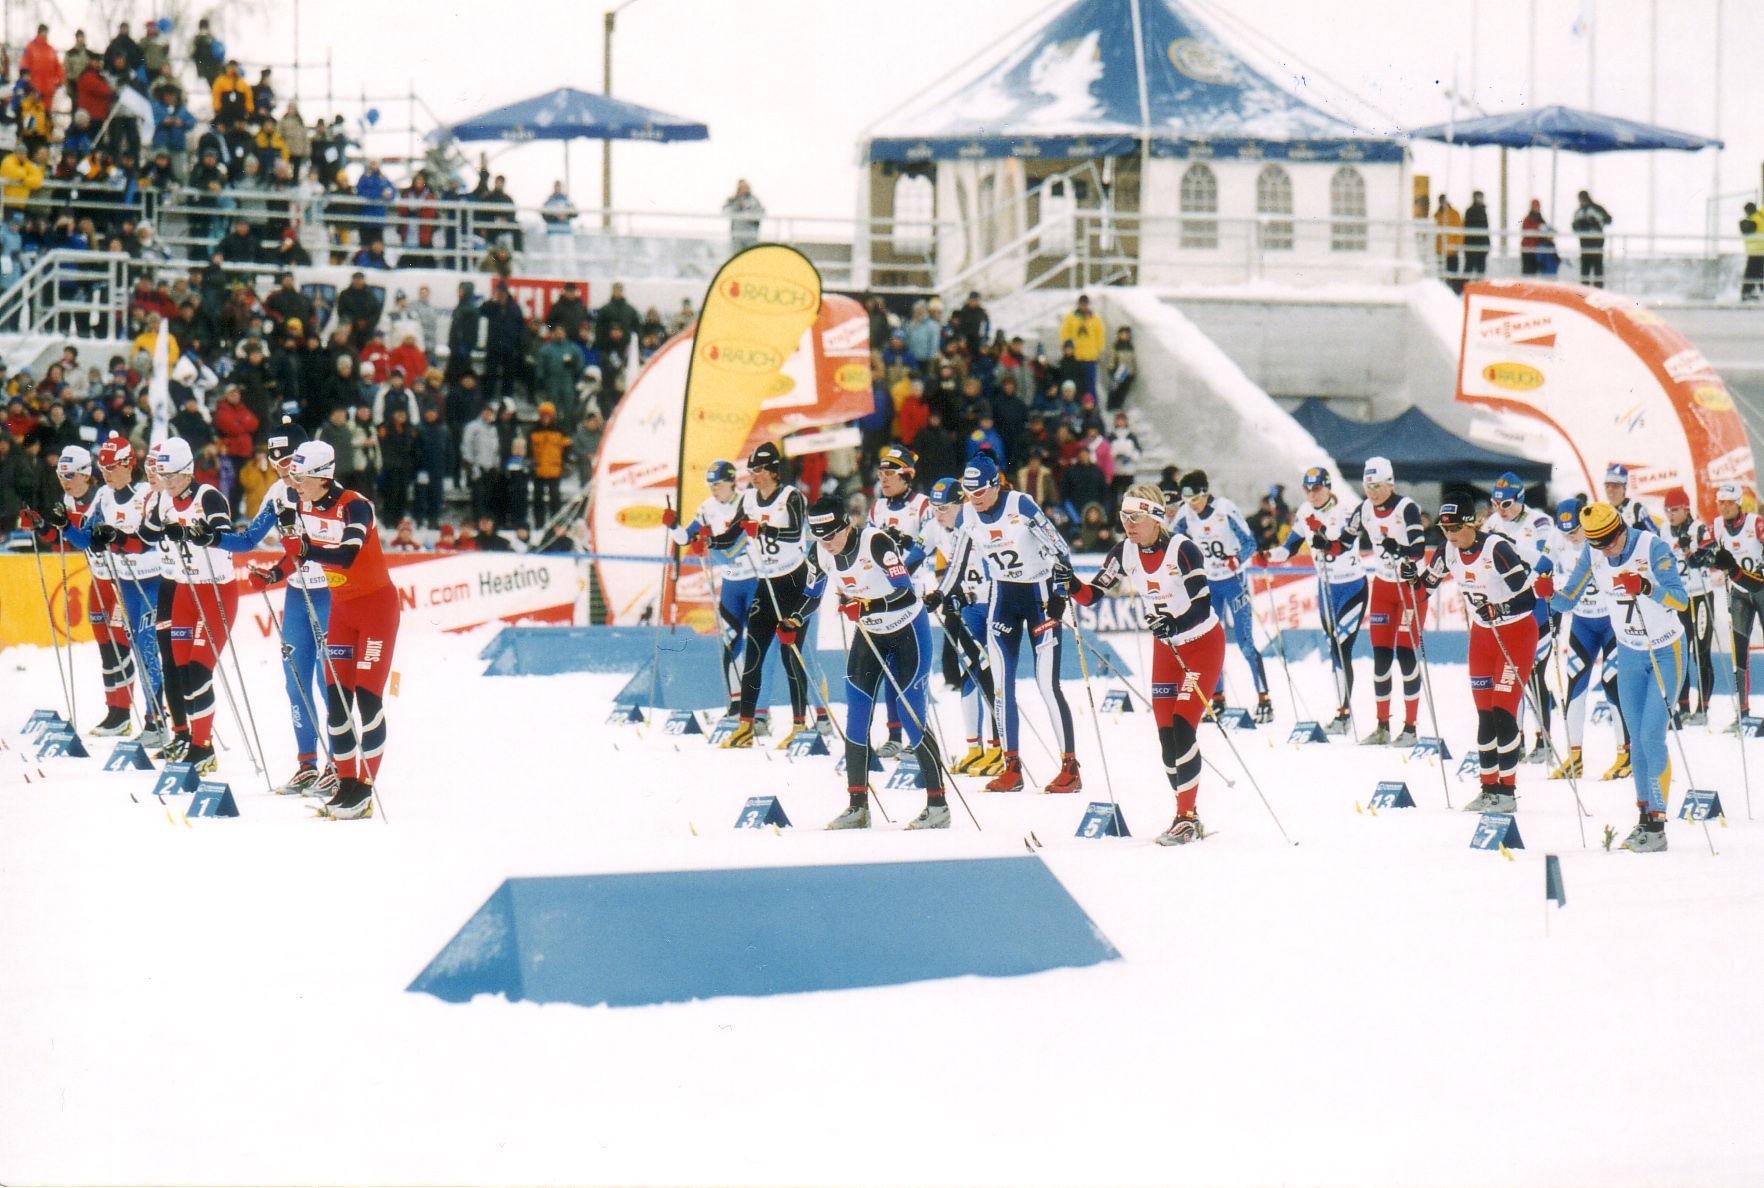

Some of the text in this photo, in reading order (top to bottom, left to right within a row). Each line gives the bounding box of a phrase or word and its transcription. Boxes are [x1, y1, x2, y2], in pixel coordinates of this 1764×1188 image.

[743, 284, 807, 305] RAUCH
[1480, 316, 1552, 340] VIESSMANN
[722, 348, 776, 366] RAUCH
[181, 540, 193, 563] 4
[758, 534, 780, 555] 18
[1200, 541, 1225, 558] 30
[988, 550, 1024, 570] 12
[309, 576, 326, 584] ESTO
[480, 564, 550, 595] Heating
[885, 610, 913, 631] ESTONIA
[1616, 599, 1635, 624] 7
[991, 620, 1013, 634] rtful
[1650, 628, 1676, 646] STONIA
[364, 639, 384, 662] SWIX
[1288, 730, 1312, 744] 26
[44, 743, 60, 758] 6
[789, 742, 812, 756] 16
[110, 755, 126, 771] 4
[159, 776, 177, 794] 2
[890, 771, 915, 789] 12
[198, 797, 211, 817] 1
[1371, 793, 1396, 808] 13
[745, 810, 760, 828] 3
[1683, 802, 1707, 820] 15
[1084, 817, 1102, 837] 5
[1479, 828, 1498, 849] 7
